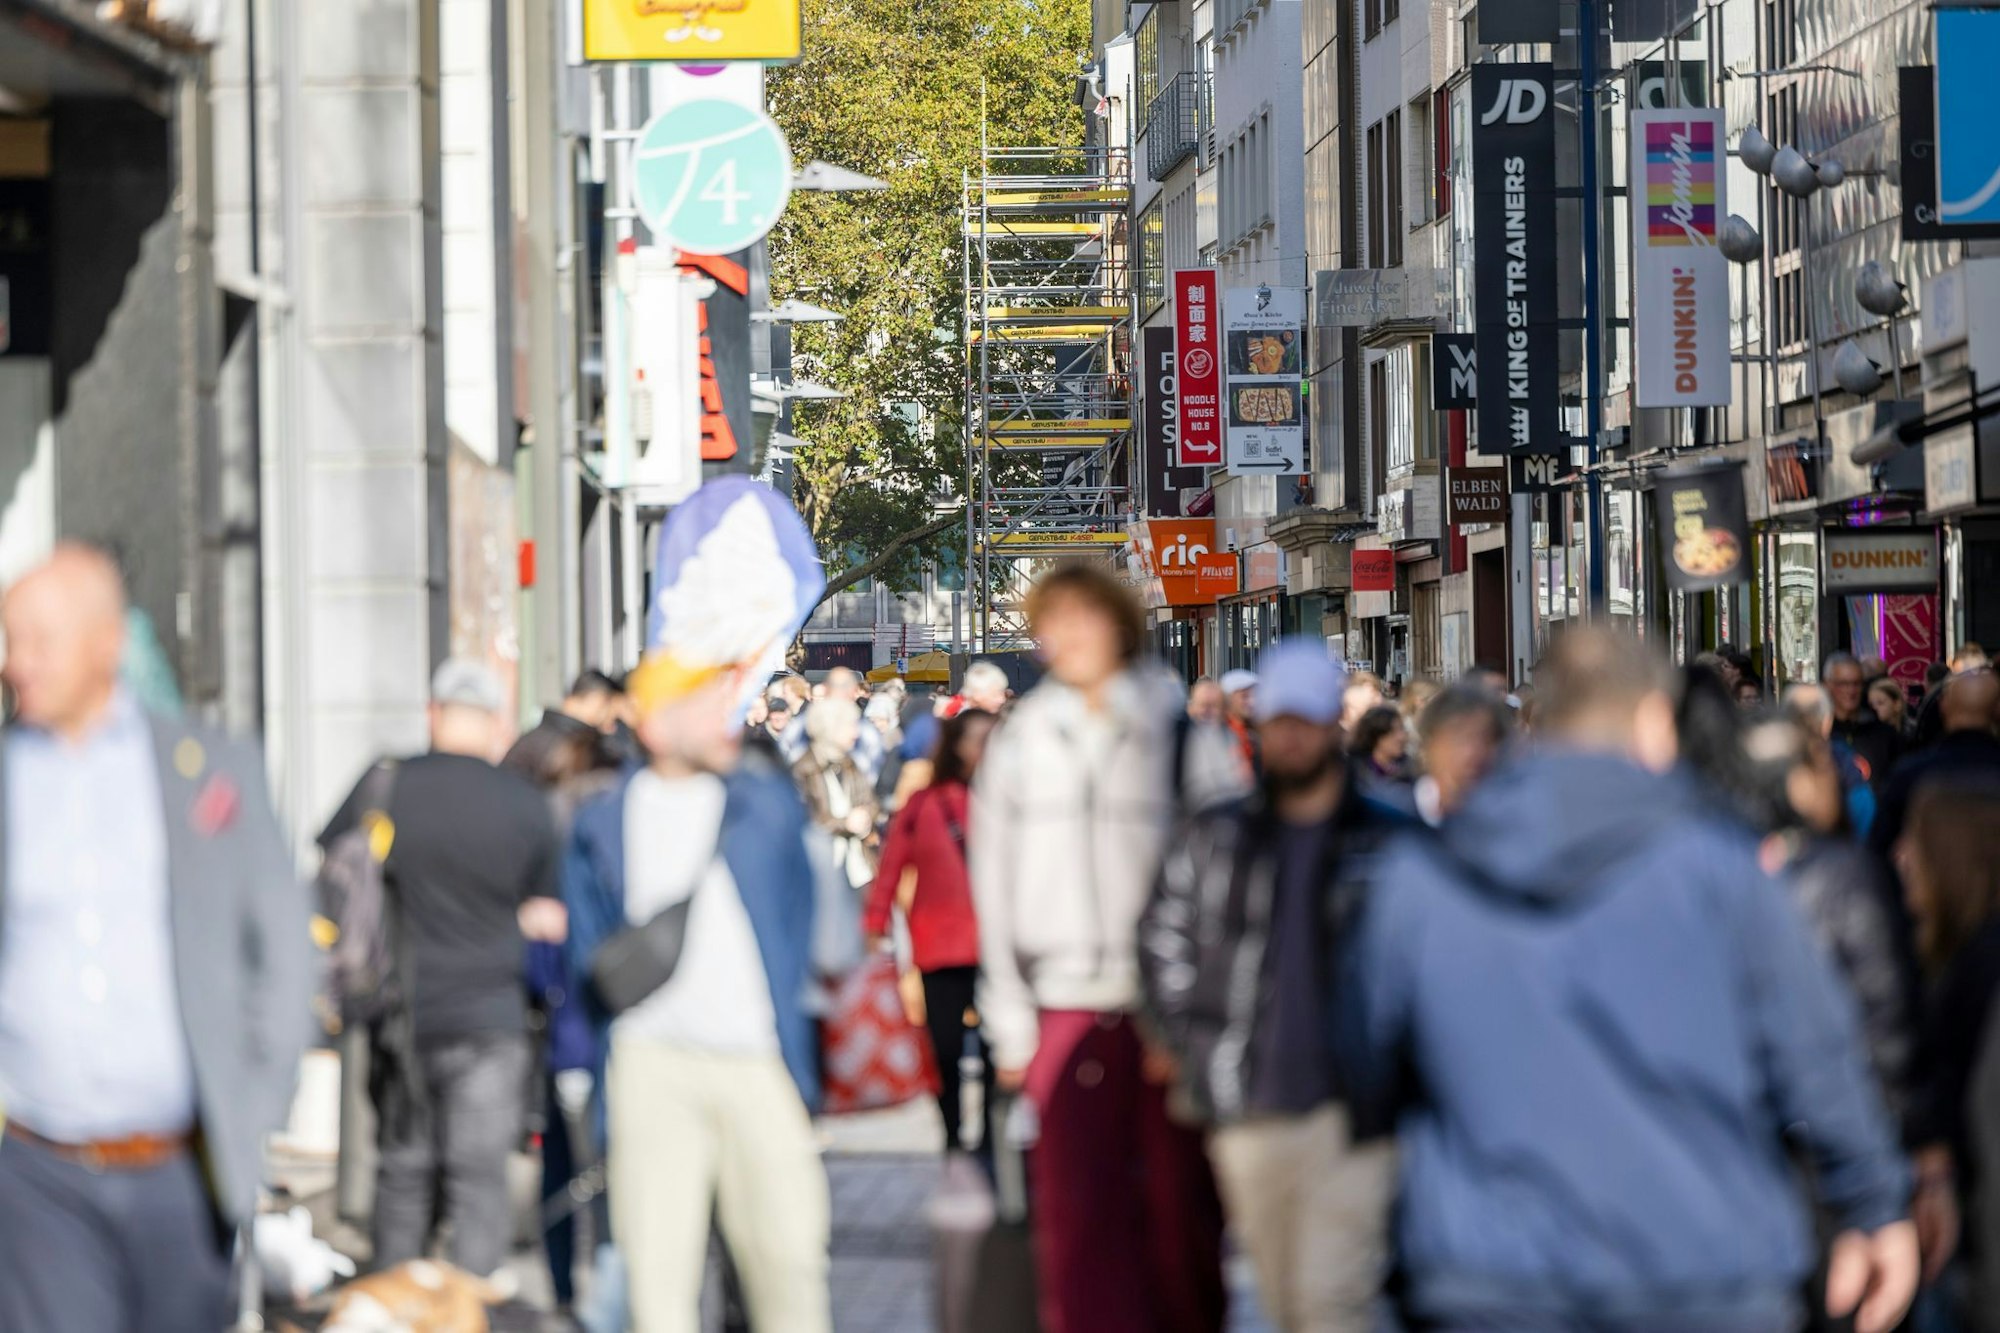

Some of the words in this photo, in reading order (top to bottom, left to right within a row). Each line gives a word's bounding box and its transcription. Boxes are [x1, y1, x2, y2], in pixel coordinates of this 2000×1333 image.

[1481, 79, 1546, 125] JD
[1662, 121, 1711, 246] jamin
[1504, 156, 1527, 297] TRAINERS
[1320, 300, 1357, 315] Fine
[1364, 300, 1400, 313] ART
[1507, 300, 1527, 328] OF
[1673, 267, 1698, 393] DUNKIN'
[1507, 330, 1529, 399] KING
[1184, 394, 1216, 404] NOODLE
[1188, 408, 1215, 418] HOUSE
[1159, 352, 1177, 491] FOSSIL
[1452, 480, 1501, 494] ELBEN
[1455, 497, 1501, 511] WALD
